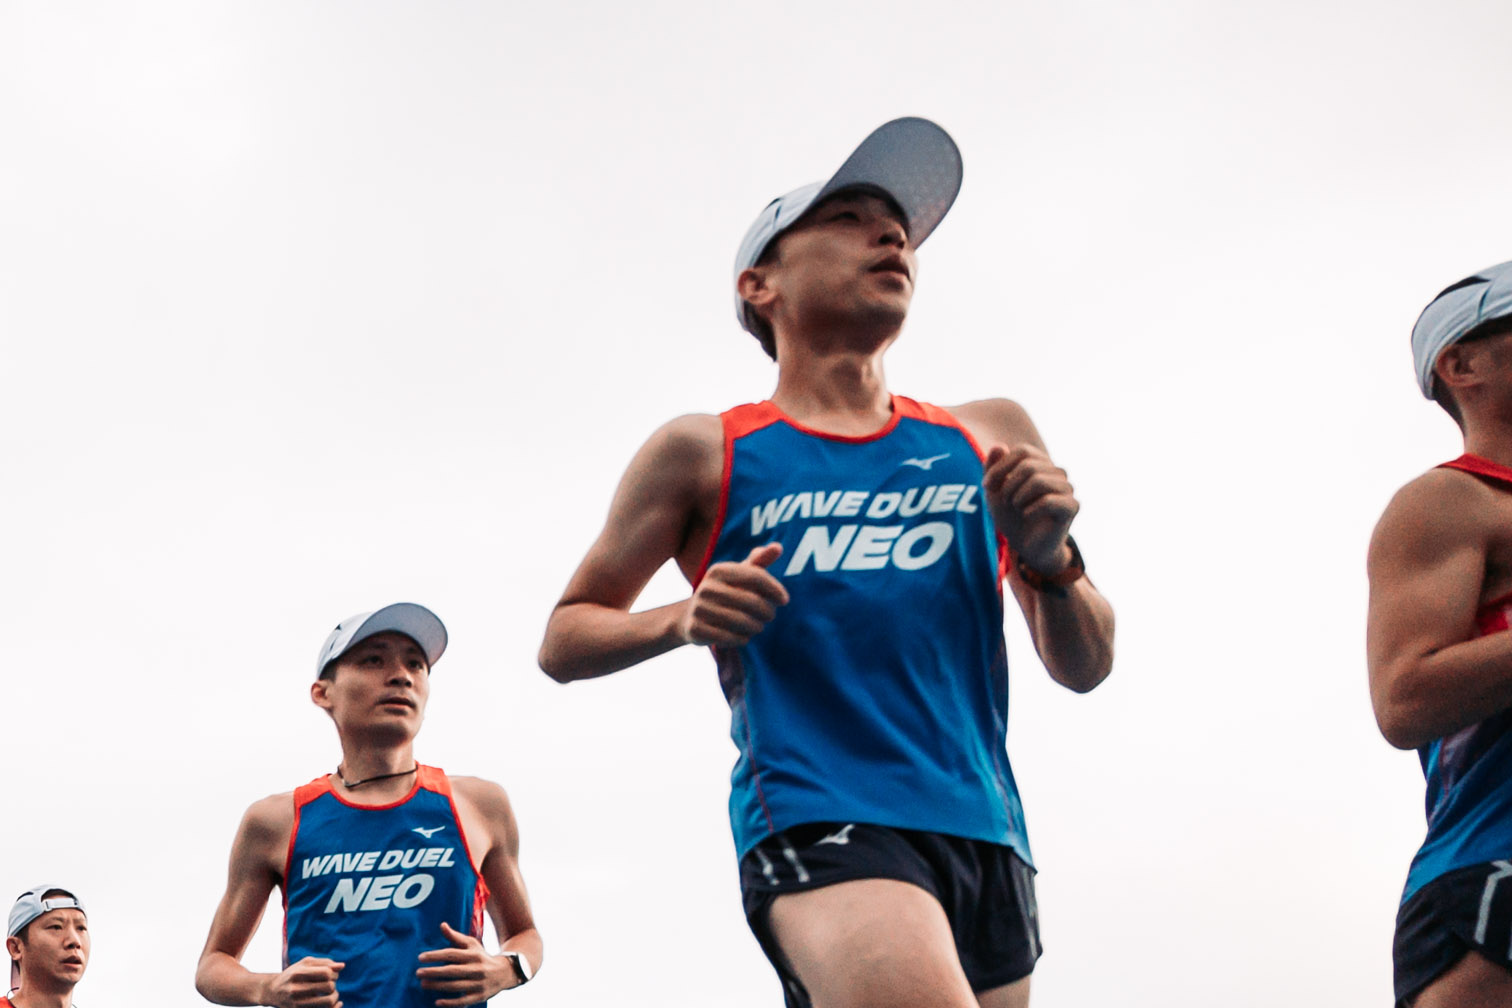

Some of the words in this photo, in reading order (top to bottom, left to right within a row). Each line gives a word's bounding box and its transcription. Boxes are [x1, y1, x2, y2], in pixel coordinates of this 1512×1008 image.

[751, 490, 871, 537] WAVE
[865, 484, 981, 519] DUEL
[783, 521, 955, 577] NEO
[301, 850, 382, 880] WAVE
[378, 847, 456, 870] DUEL
[324, 873, 436, 914] NEO
